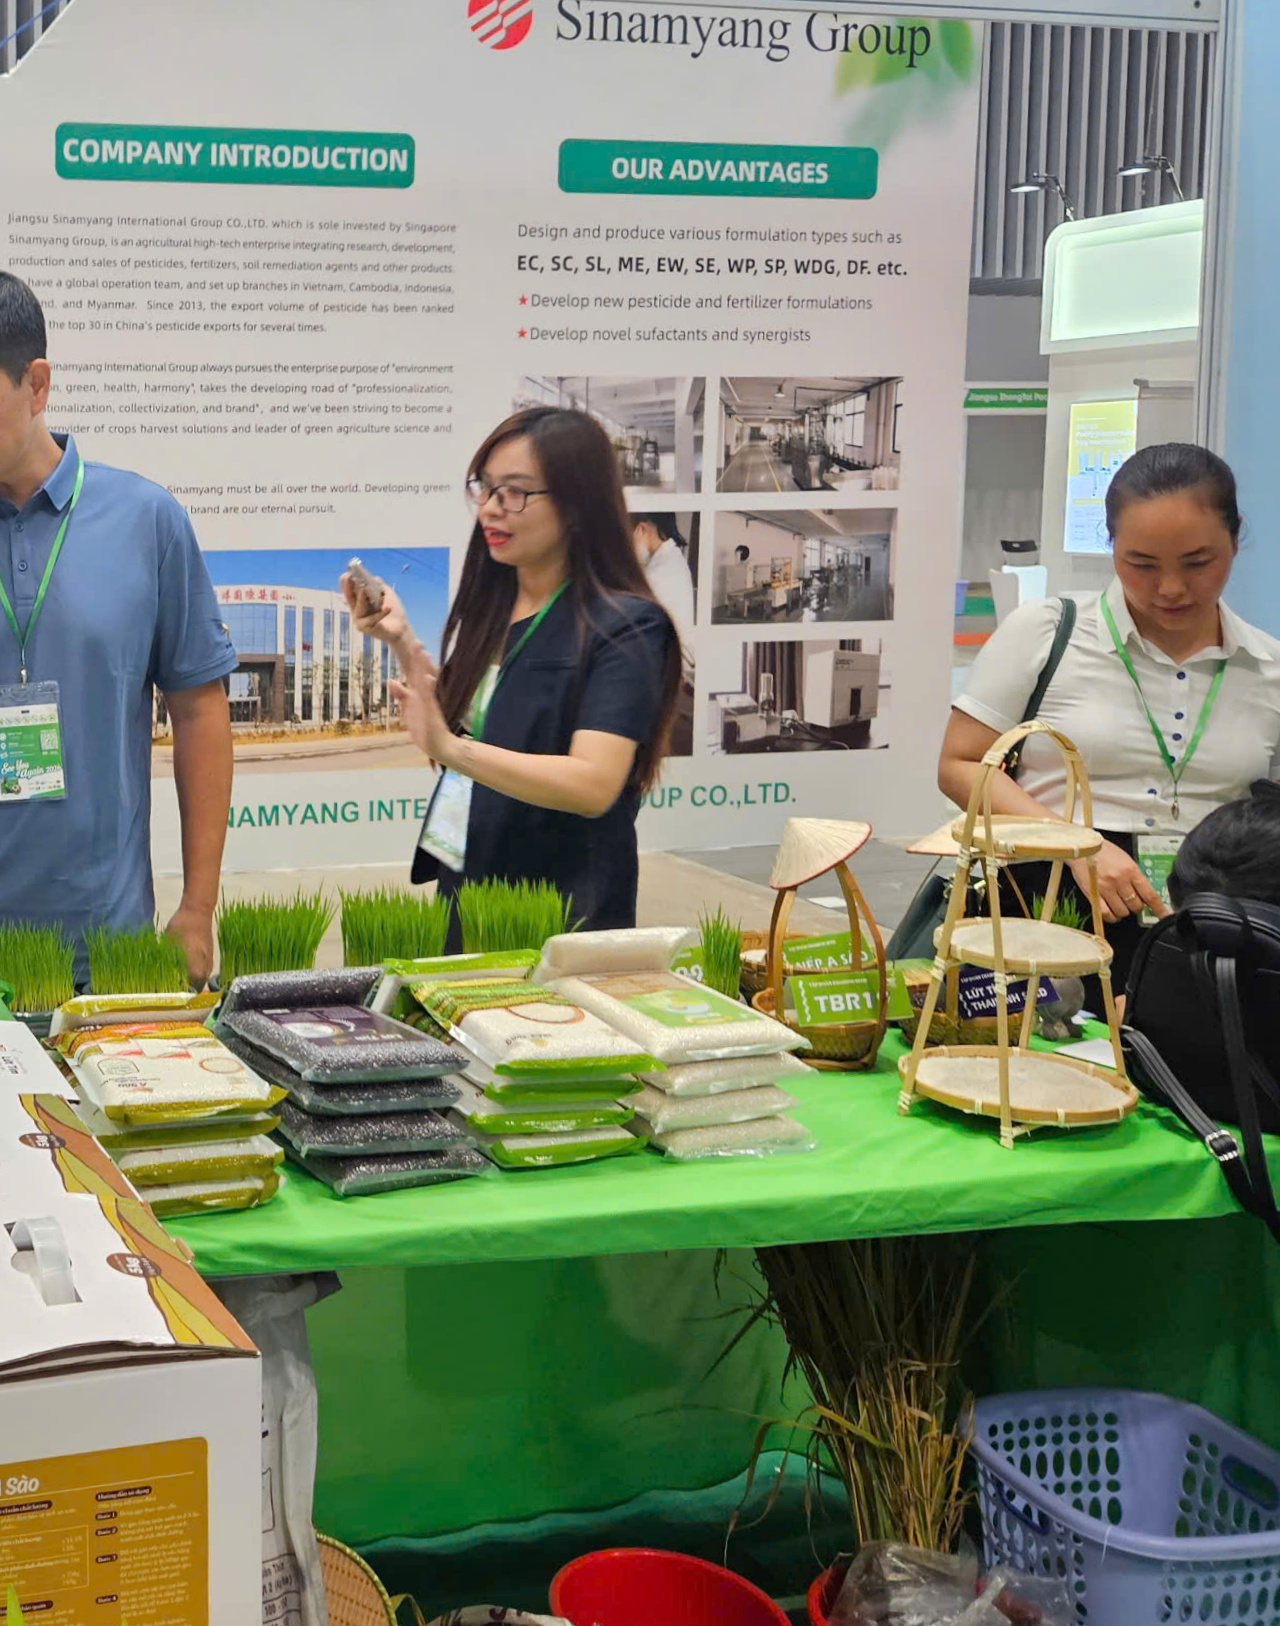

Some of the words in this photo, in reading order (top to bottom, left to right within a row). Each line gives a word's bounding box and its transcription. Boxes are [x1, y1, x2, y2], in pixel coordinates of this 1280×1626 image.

[556, 0, 791, 62] Sinamyang
[805, 12, 932, 68] Group
[62, 138, 203, 167] COMPANY
[210, 142, 410, 173] INTRODUCTION
[611, 157, 664, 181] OUR
[668, 159, 830, 185] ADVANTAGES
[7, 212, 49, 226] Jiangsu
[52, 213, 114, 228] Sinamyang
[117, 215, 187, 227] International
[189, 216, 223, 230] Group
[226, 217, 268, 229] CO.,LTD.
[271, 218, 303, 230] which
[305, 220, 315, 230] is
[318, 219, 340, 231] sole
[342, 220, 387, 232] invested
[388, 221, 402, 234] by
[404, 221, 457, 235] Singapore
[517, 223, 569, 242] Design
[572, 223, 601, 240] and
[605, 224, 666, 243] produce
[669, 226, 722, 242] various
[725, 226, 808, 243] formulation
[810, 229, 849, 246] types
[851, 229, 884, 244] such
[886, 232, 903, 245] as
[8, 255, 66, 268] production
[67, 257, 89, 267] and
[91, 257, 118, 268] sales
[120, 257, 132, 268] of
[133, 258, 188, 271] pesticides,
[190, 258, 240, 271] fertilizers,
[242, 259, 260, 270] soil
[262, 260, 323, 272] remediation
[324, 261, 359, 274] agents
[360, 262, 381, 273] and
[382, 262, 409, 273] other
[410, 263, 455, 276] products.
[516, 254, 545, 275] EC,
[550, 254, 580, 276] SC,
[584, 255, 612, 276] SL,
[617, 255, 651, 276] ME,
[656, 256, 689, 277] EW,
[694, 256, 722, 277] SE,
[727, 257, 759, 277] WP,
[763, 257, 789, 277] SP,
[793, 258, 842, 278] WDG,
[846, 259, 872, 276] DF.
[876, 260, 908, 277] etc.
[530, 292, 591, 311] Develop
[593, 296, 625, 308] new
[627, 293, 692, 312] pesticide
[694, 294, 723, 309] and
[726, 294, 784, 310] fertilizer
[786, 294, 873, 311] formulations
[529, 326, 589, 344] Develop
[592, 326, 632, 342] novel
[635, 326, 708, 342] sufactants
[711, 326, 739, 342] and
[742, 327, 812, 345] synergists
[65, 383, 100, 395] green,
[103, 381, 140, 394] health,
[143, 381, 196, 395] harmony",
[199, 382, 228, 394] takes
[230, 382, 248, 394] the
[250, 382, 308, 395] developing
[310, 383, 335, 394] road
[337, 383, 349, 394] of
[351, 383, 453, 396] "professionalization,
[226, 484, 252, 495] must
[254, 483, 268, 494] be
[270, 483, 284, 494] all
[285, 485, 309, 494] over
[310, 484, 328, 494] the
[329, 483, 362, 494] world.
[364, 483, 420, 495] Developing
[422, 484, 451, 495] green
[690, 782, 797, 809] CO.,LTD.
[5, 1474, 41, 1496] Sào
